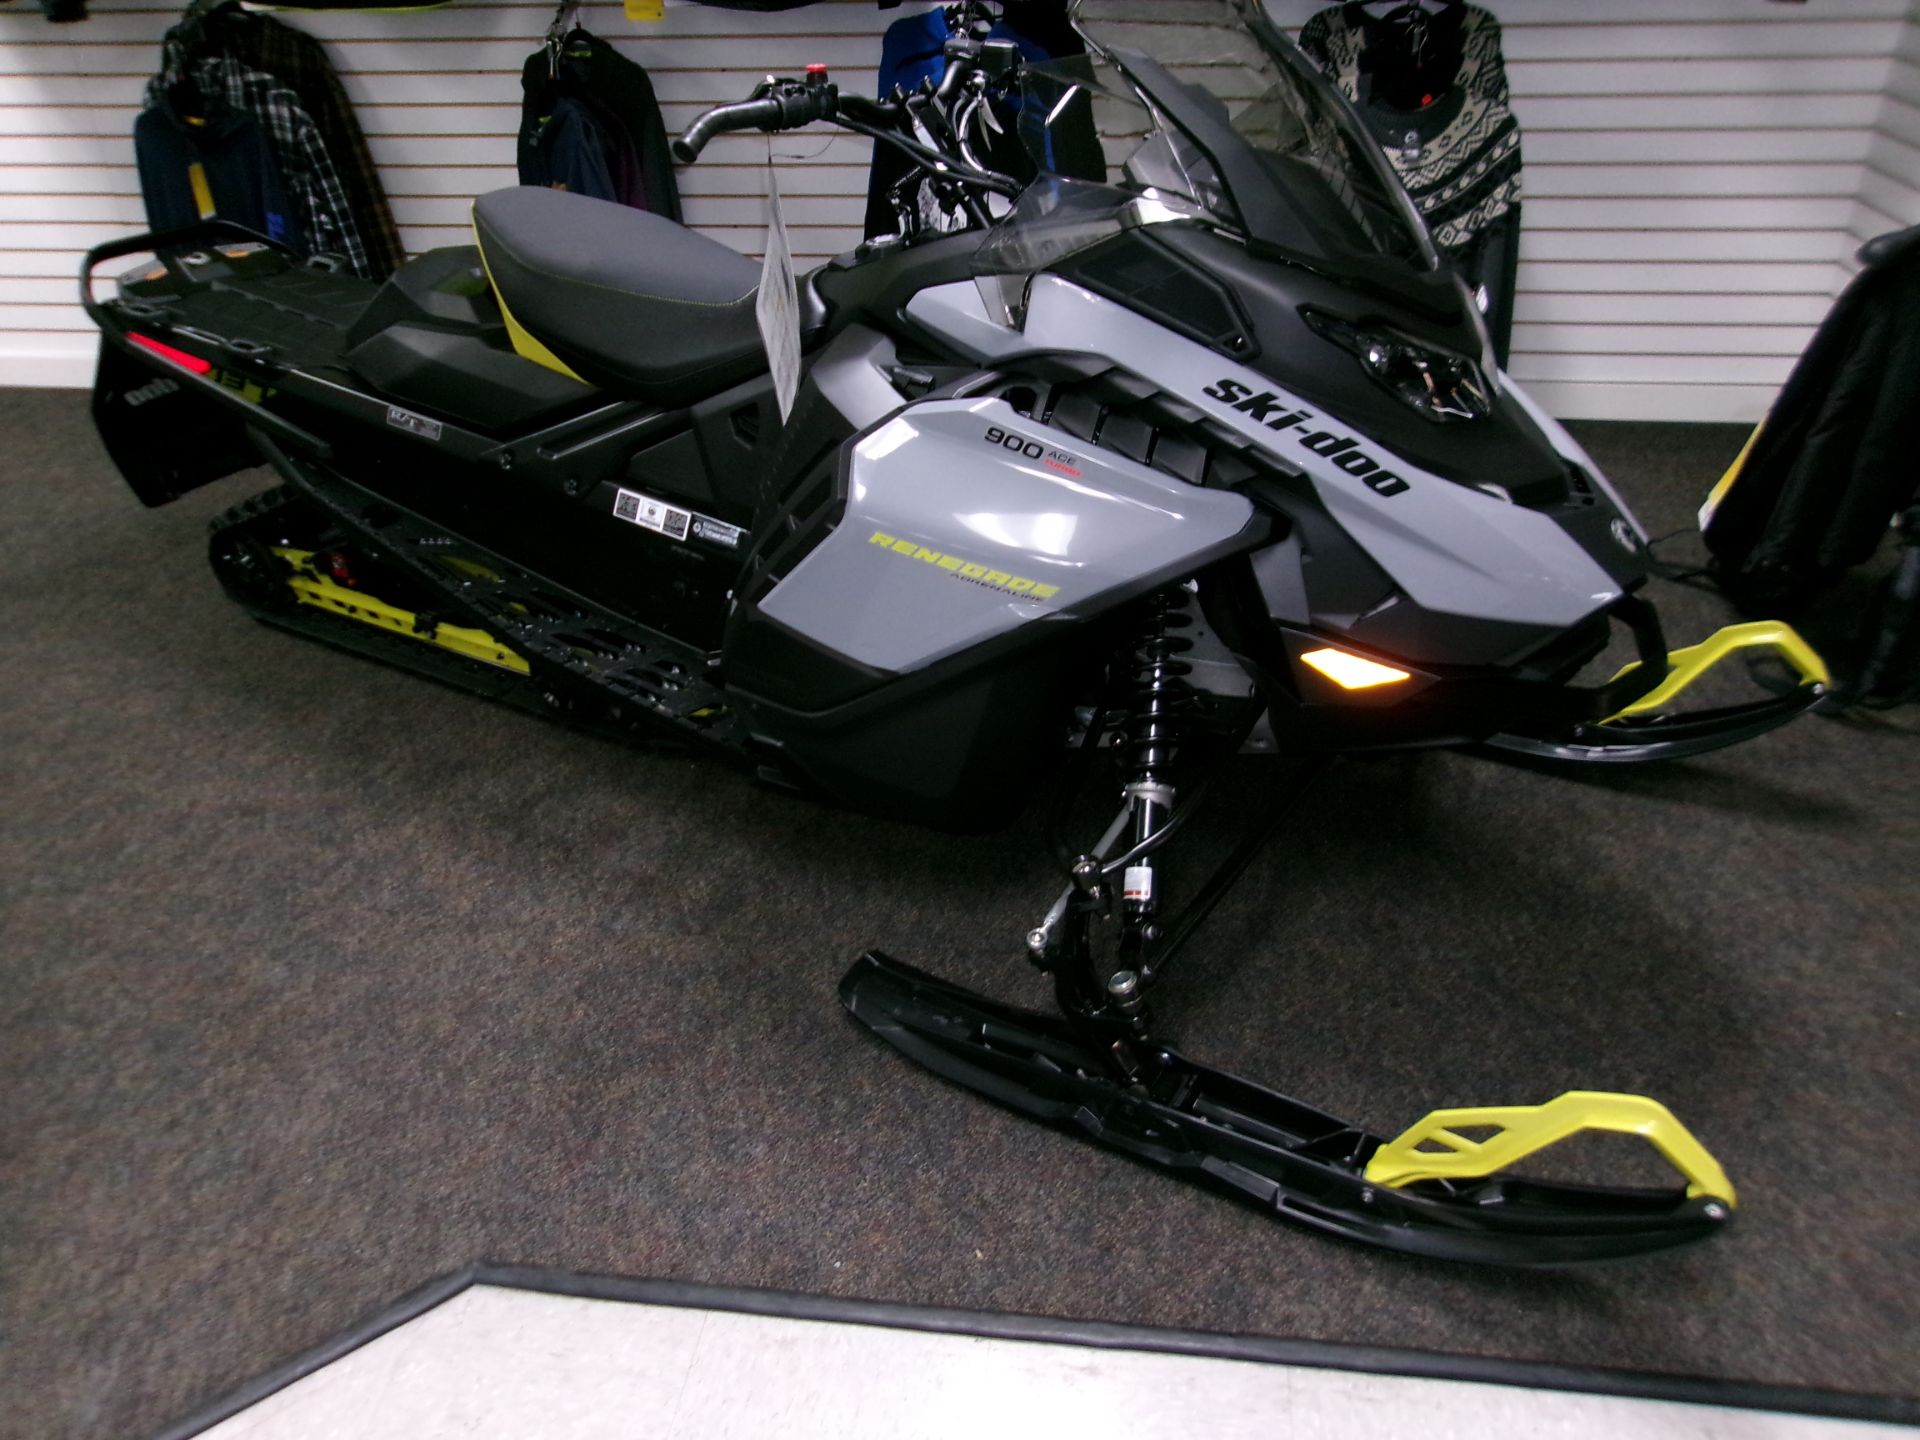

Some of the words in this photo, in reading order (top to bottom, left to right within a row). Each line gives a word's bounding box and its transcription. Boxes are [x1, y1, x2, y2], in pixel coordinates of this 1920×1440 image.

[984, 426, 1044, 460] 900
[1047, 450, 1077, 466] ACE
[1202, 379, 1411, 497] ski-doo
[868, 531, 1061, 598] RENEGADE
[949, 572, 1046, 602] ADRENALINE
